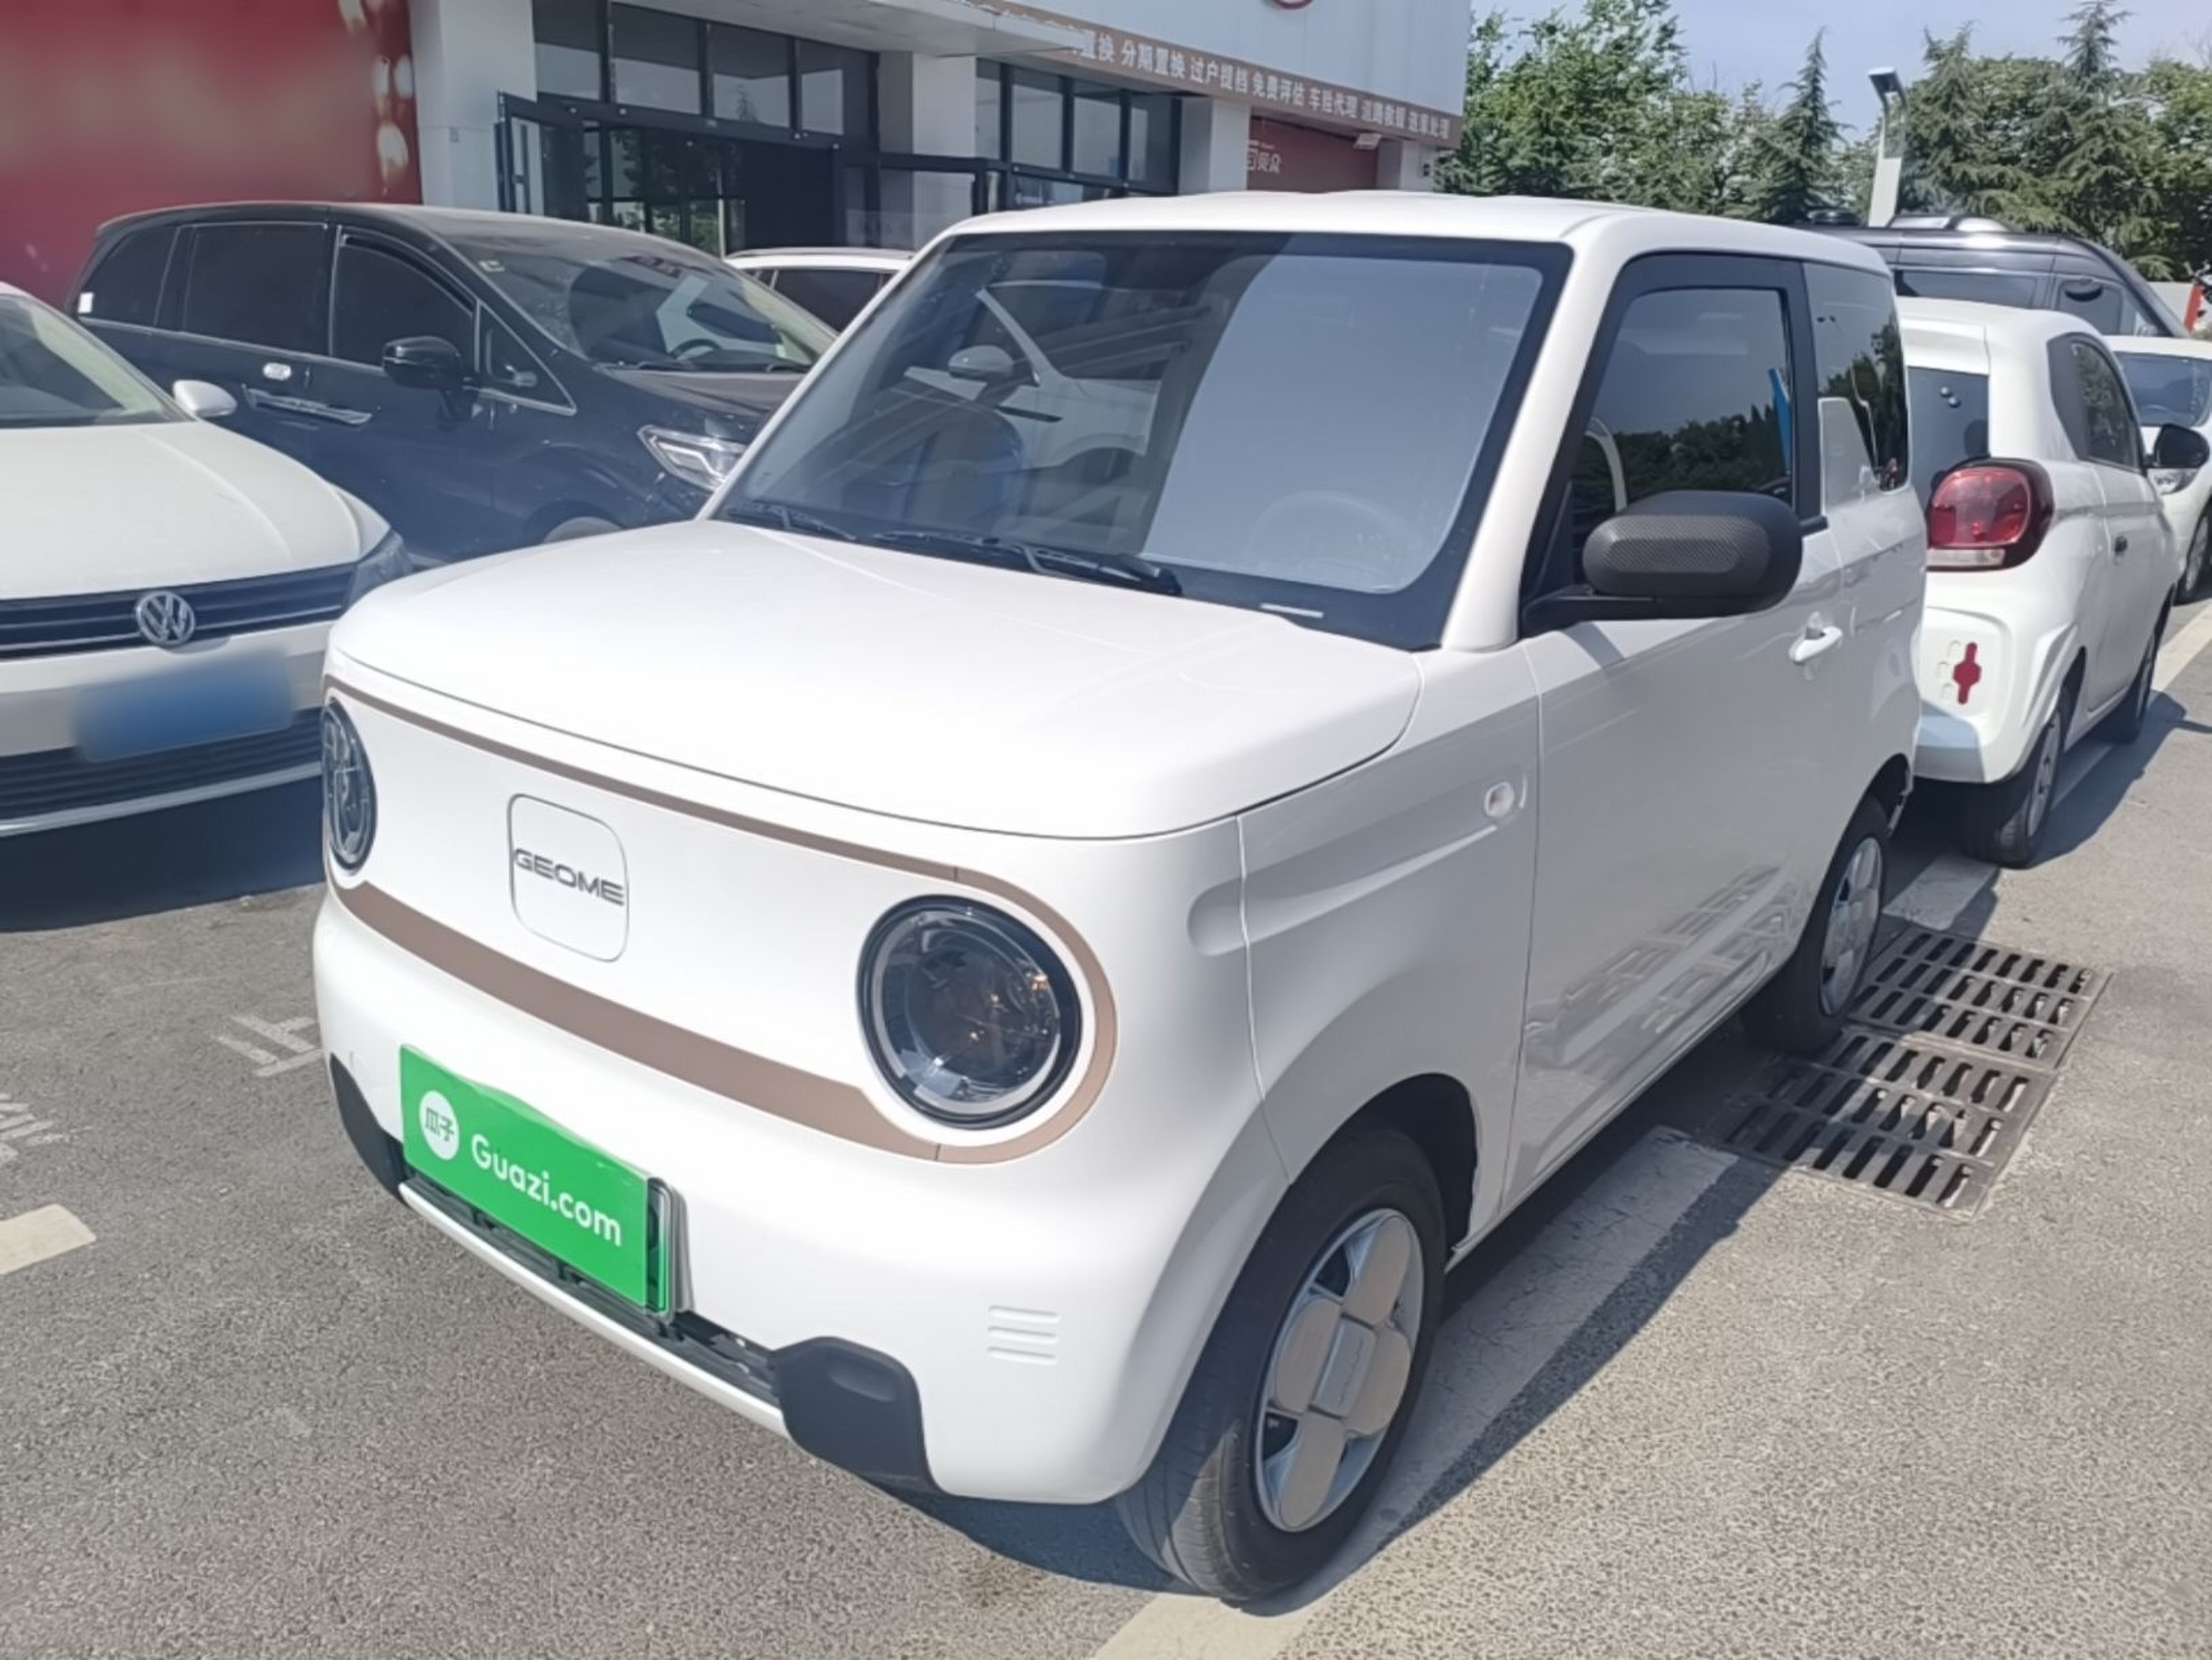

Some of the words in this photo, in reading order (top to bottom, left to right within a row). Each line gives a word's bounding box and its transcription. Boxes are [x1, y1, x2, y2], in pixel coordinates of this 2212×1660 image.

[1122, 40, 1184, 79] 分期置换
[1191, 56, 1248, 94] 过户提档
[1252, 72, 1305, 106] 免费评估
[1309, 88, 1358, 119] 车险代理
[514, 848, 624, 906] GEOME
